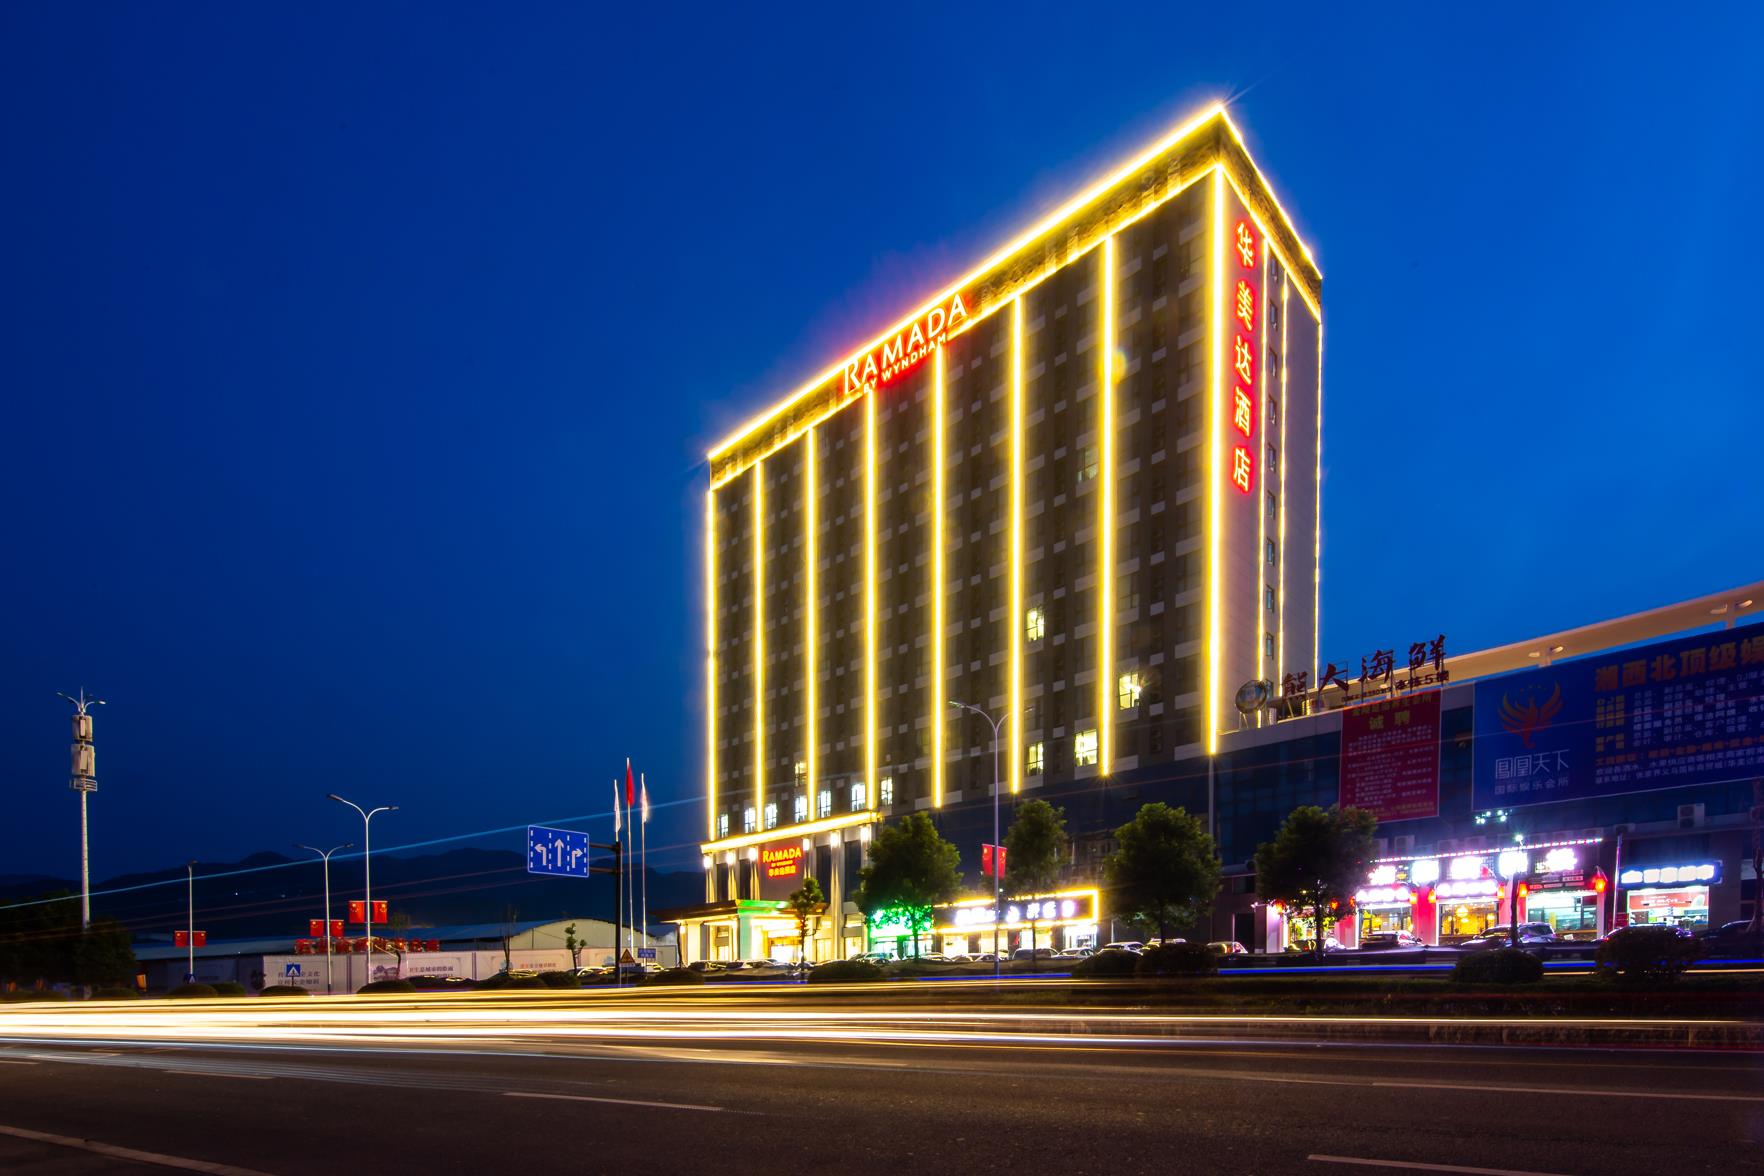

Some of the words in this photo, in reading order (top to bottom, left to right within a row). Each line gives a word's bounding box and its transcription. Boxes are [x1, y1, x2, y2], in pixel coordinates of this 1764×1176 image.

[843, 294, 968, 395] RAMADA
[863, 377, 878, 394] BY
[881, 332, 946, 381] WYNDHAM
[1233, 222, 1254, 492] 华美达酒店
[762, 847, 801, 863] RAMADA
